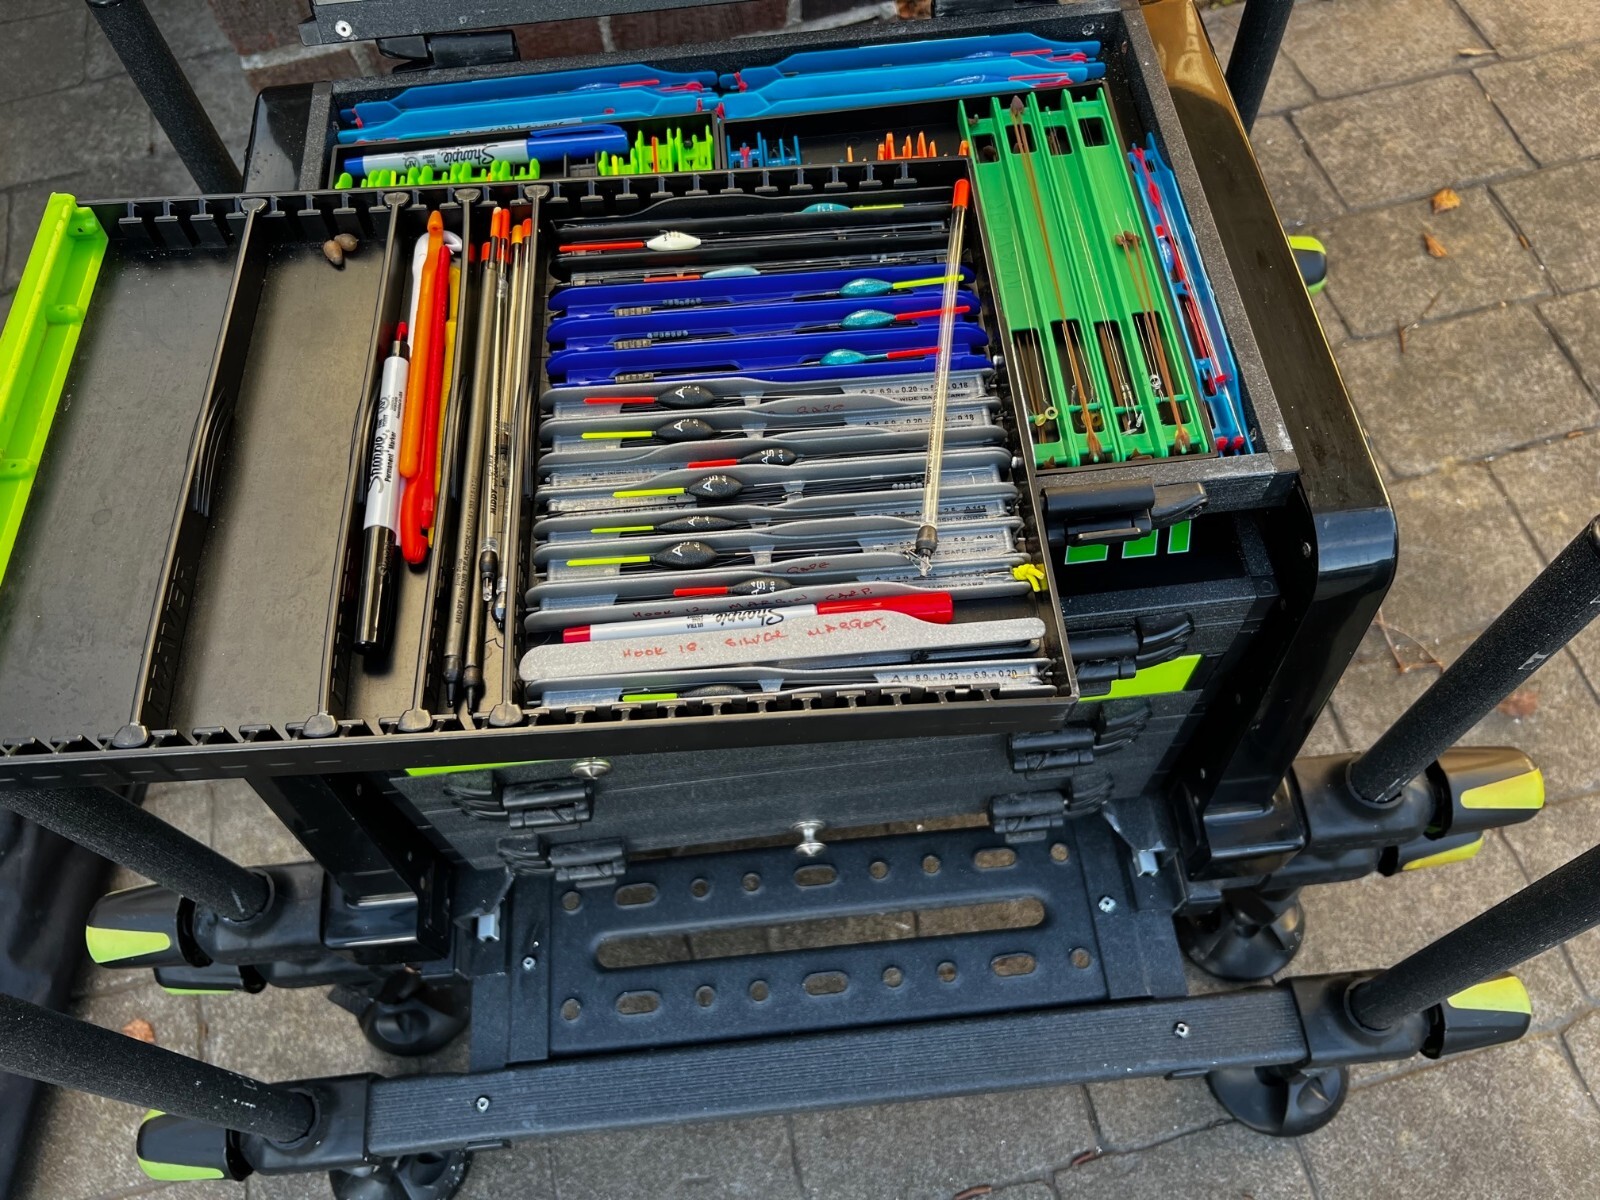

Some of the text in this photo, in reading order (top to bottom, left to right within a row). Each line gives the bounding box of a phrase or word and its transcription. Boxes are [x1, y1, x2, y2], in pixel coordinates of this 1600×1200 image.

[441, 145, 499, 165] Sharpie
[901, 385, 918, 393] 0.20
[368, 433, 388, 493] Sharpie
[384, 431, 397, 483] Permanent Marker
[490, 488, 498, 515] MIDDY
[455, 600, 465, 625] MIDDY
[714, 607, 785, 626] Sharpie
[623, 645, 668, 659] HOOK
[940, 672, 959, 680] 0.23
[998, 669, 1017, 678] 0.20
